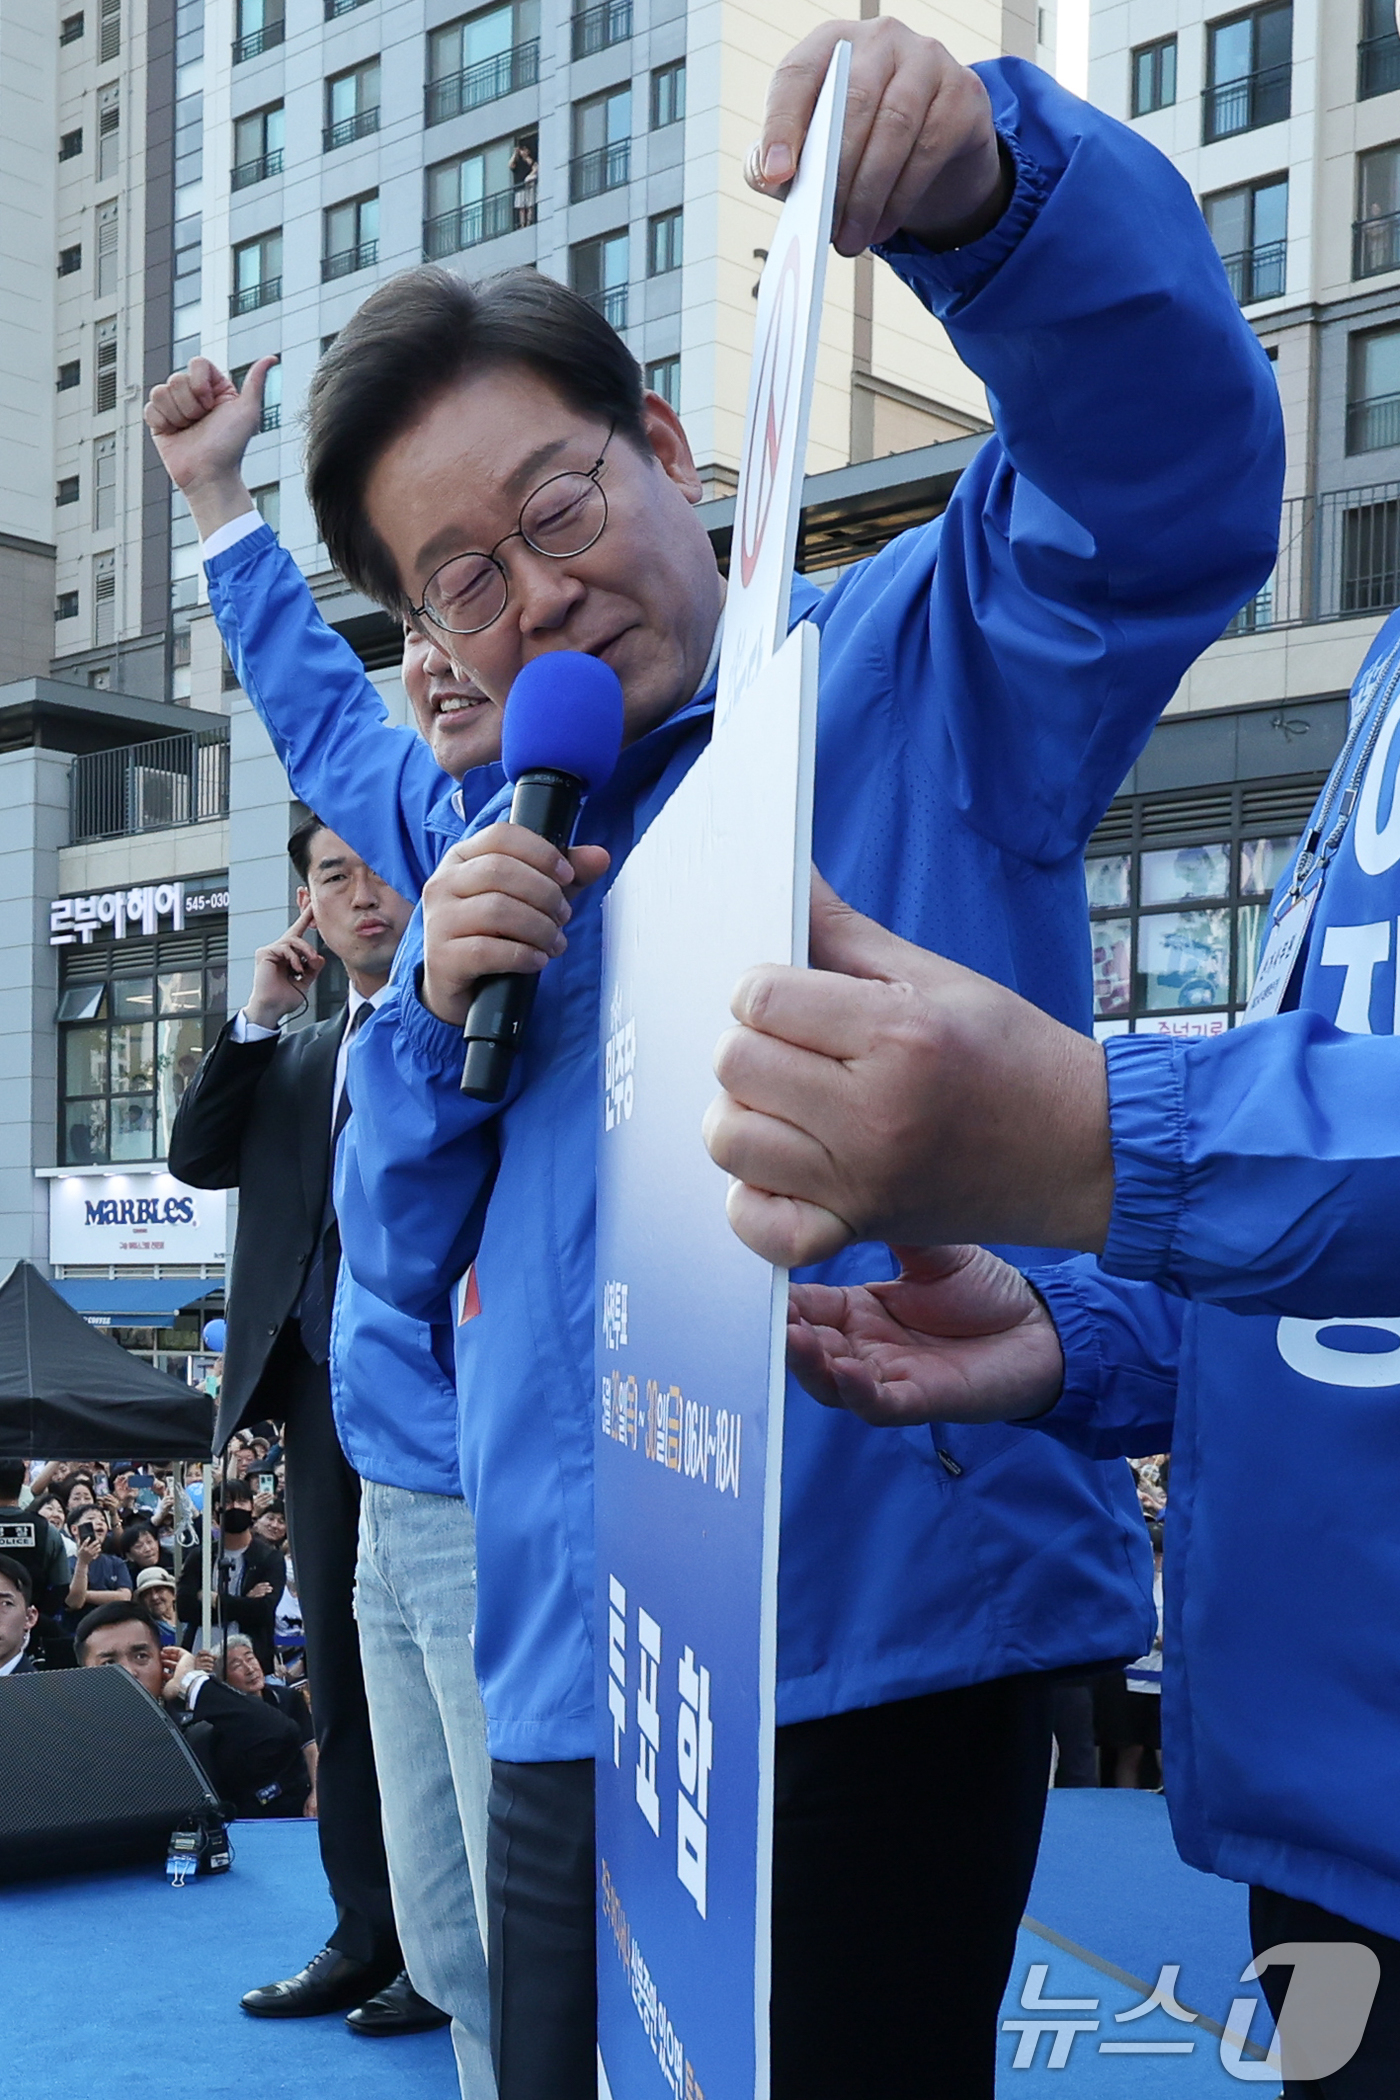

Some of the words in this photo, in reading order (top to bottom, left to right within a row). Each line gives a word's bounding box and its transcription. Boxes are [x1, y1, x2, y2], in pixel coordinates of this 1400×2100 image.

[50, 881, 185, 945] 르부아헤어
[605, 1016, 636, 1132] 민주당
[608, 1572, 713, 1921] 투표함
